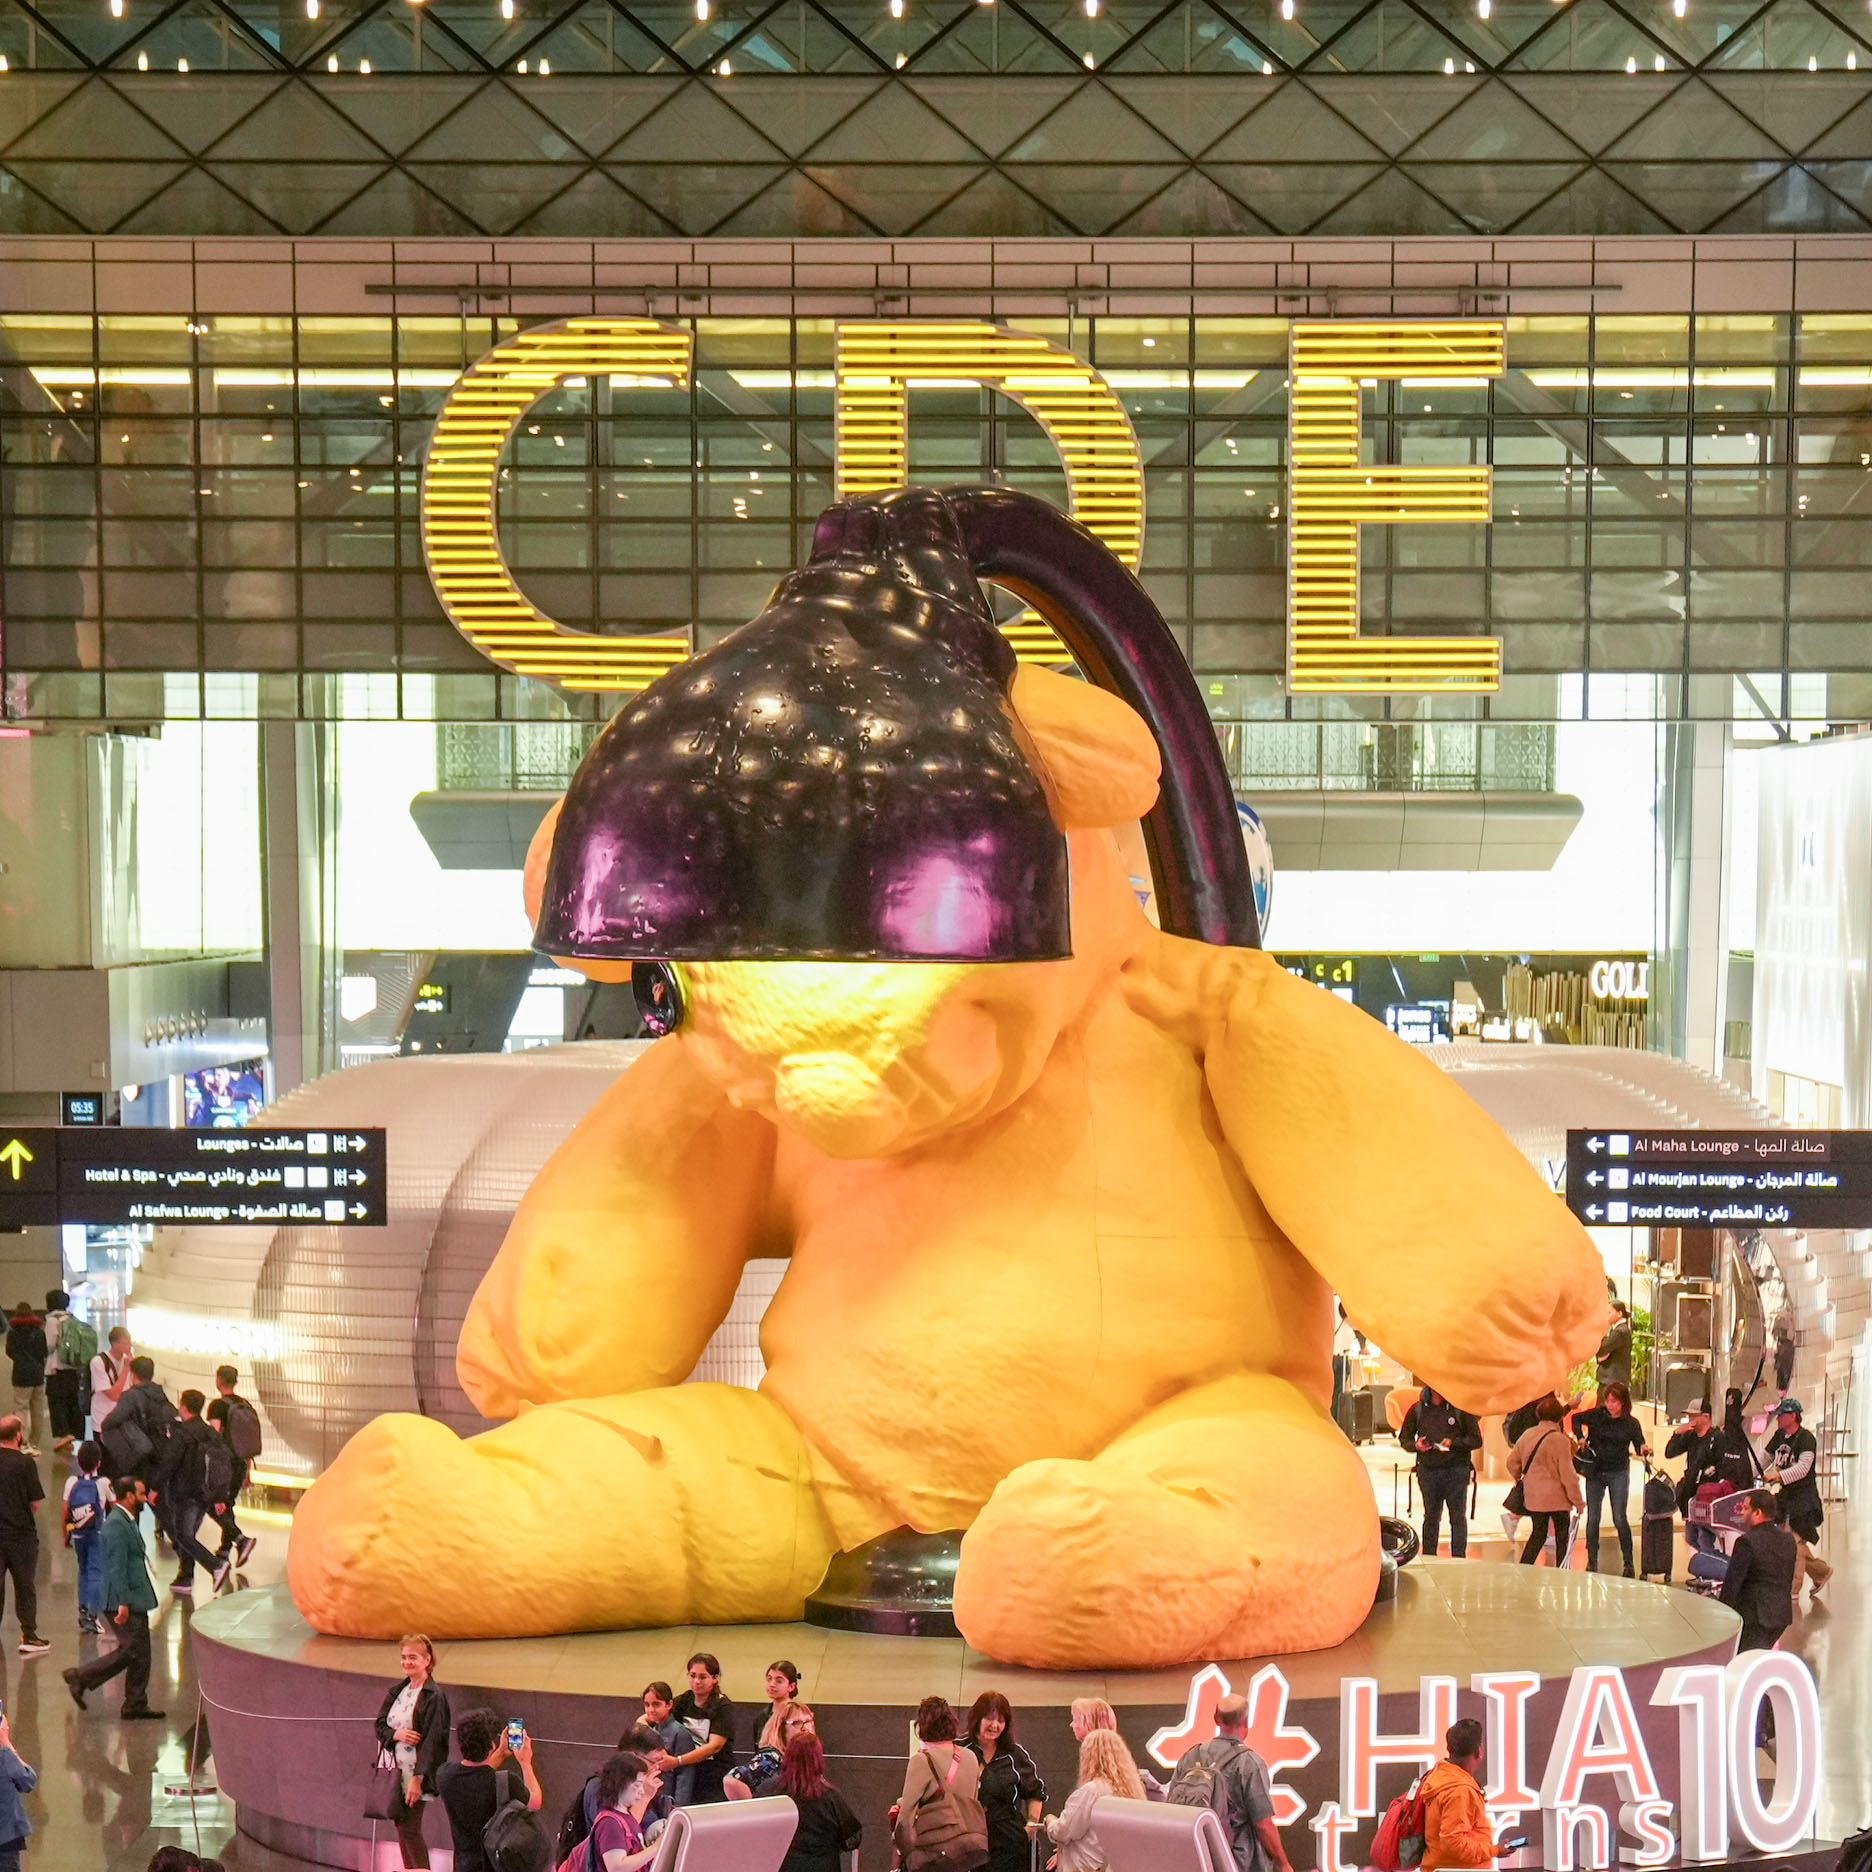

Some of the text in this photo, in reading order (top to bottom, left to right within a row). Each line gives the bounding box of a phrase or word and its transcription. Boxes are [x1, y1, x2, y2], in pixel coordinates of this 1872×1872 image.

[70, 1101, 94, 1114] 05:35
[196, 1138, 250, 1153] Lounges
[260, 1136, 304, 1152] صالات
[1634, 1140, 1648, 1151] Al
[1652, 1140, 1688, 1152] Maha
[1691, 1140, 1740, 1155] Lounge
[1754, 1139, 1825, 1157] صالة المها
[85, 1168, 120, 1182] Hotel
[120, 1169, 130, 1182] &
[132, 1168, 158, 1185] Spa
[167, 1168, 281, 1188] فندق ونادي صحي
[1632, 1174, 1646, 1186] Al
[1648, 1173, 1698, 1188] Mourjan
[1700, 1174, 1745, 1190] Lounge
[1756, 1172, 1838, 1190] صالة المرجان
[129, 1204, 144, 1217] Al
[144, 1204, 182, 1218] Safwa
[184, 1204, 230, 1221] Lounge
[238, 1204, 322, 1219] صالة الصفوة
[1631, 1205, 1662, 1218] Food
[1664, 1205, 1700, 1218] Court
[1710, 1204, 1788, 1222] ركن المطاعم
